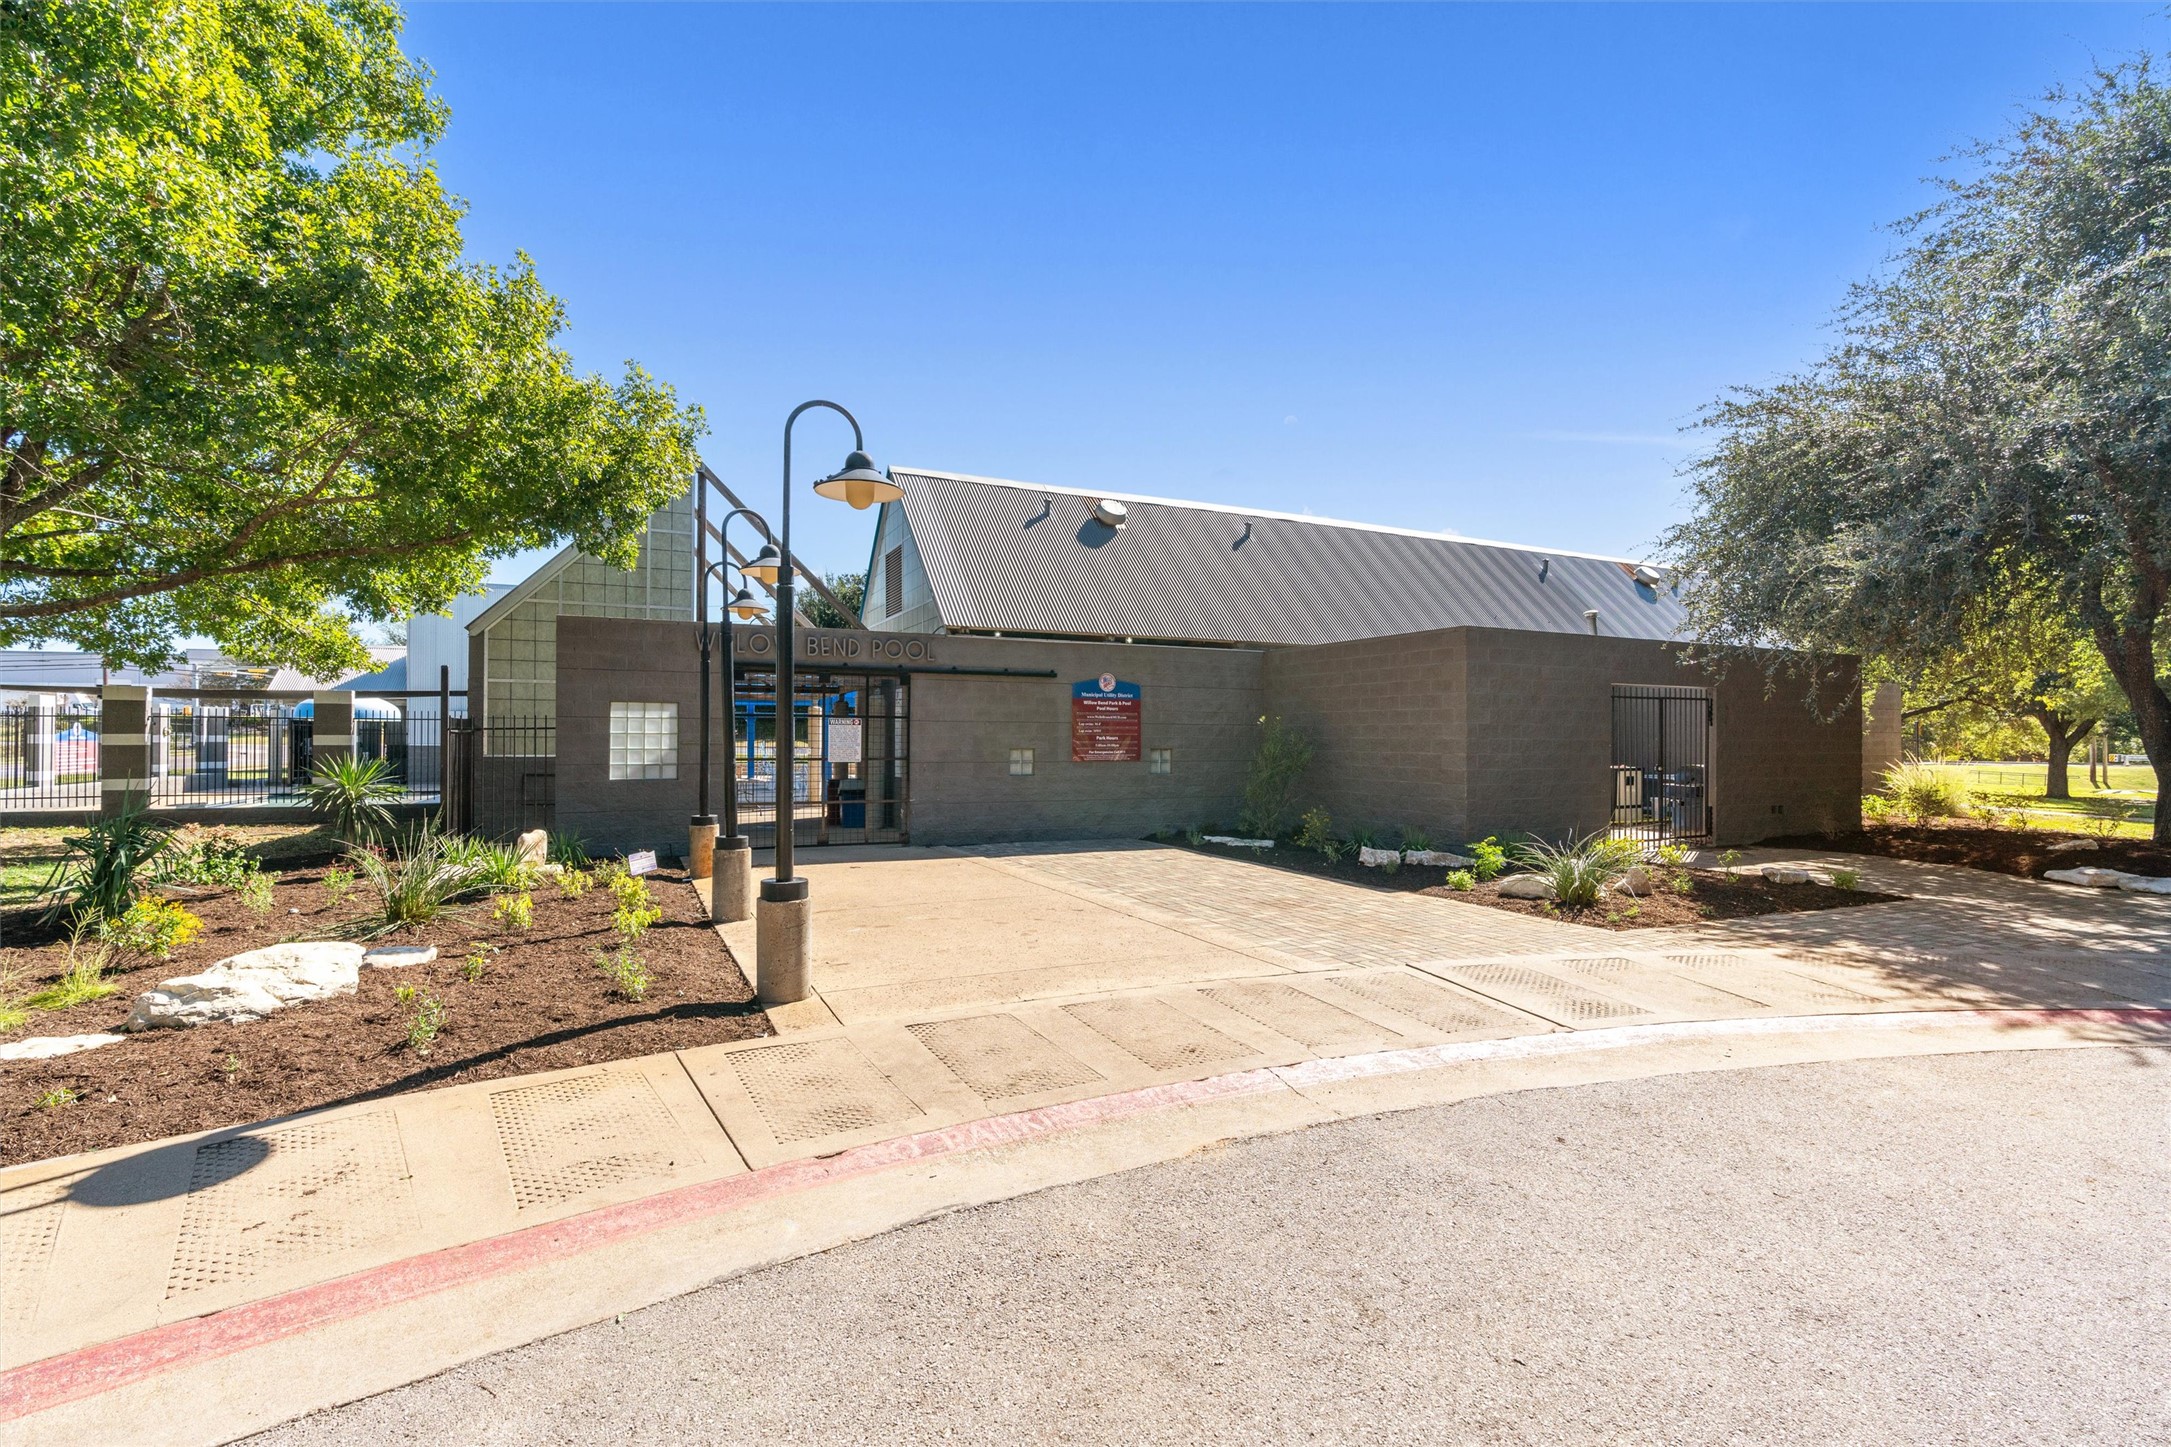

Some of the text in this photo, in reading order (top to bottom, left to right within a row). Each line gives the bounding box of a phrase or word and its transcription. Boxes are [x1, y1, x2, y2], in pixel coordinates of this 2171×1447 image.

[696, 631, 936, 662] WILO BEND POOL
